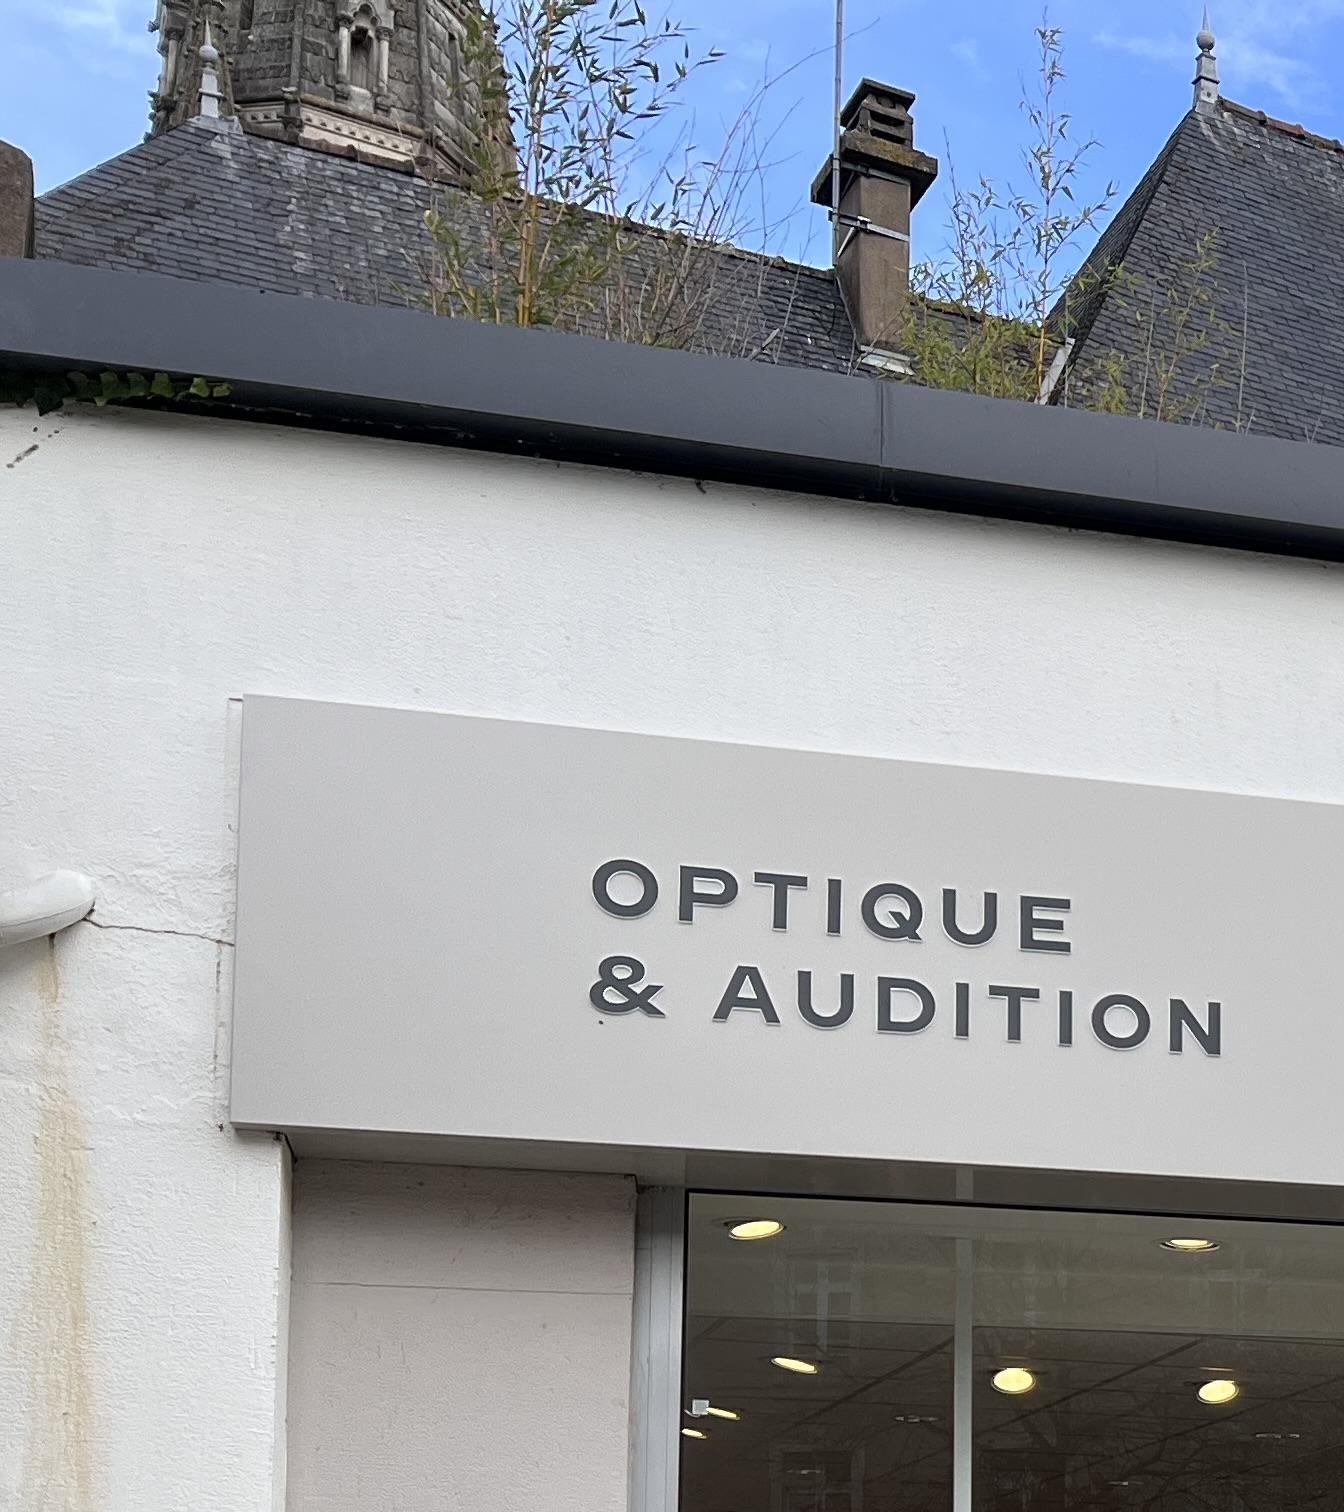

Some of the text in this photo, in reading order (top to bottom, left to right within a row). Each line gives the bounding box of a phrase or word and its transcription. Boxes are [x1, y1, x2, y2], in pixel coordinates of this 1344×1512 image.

[592, 859, 1072, 954] OPTIQUE
[589, 955, 1221, 1057] & AUDITION
